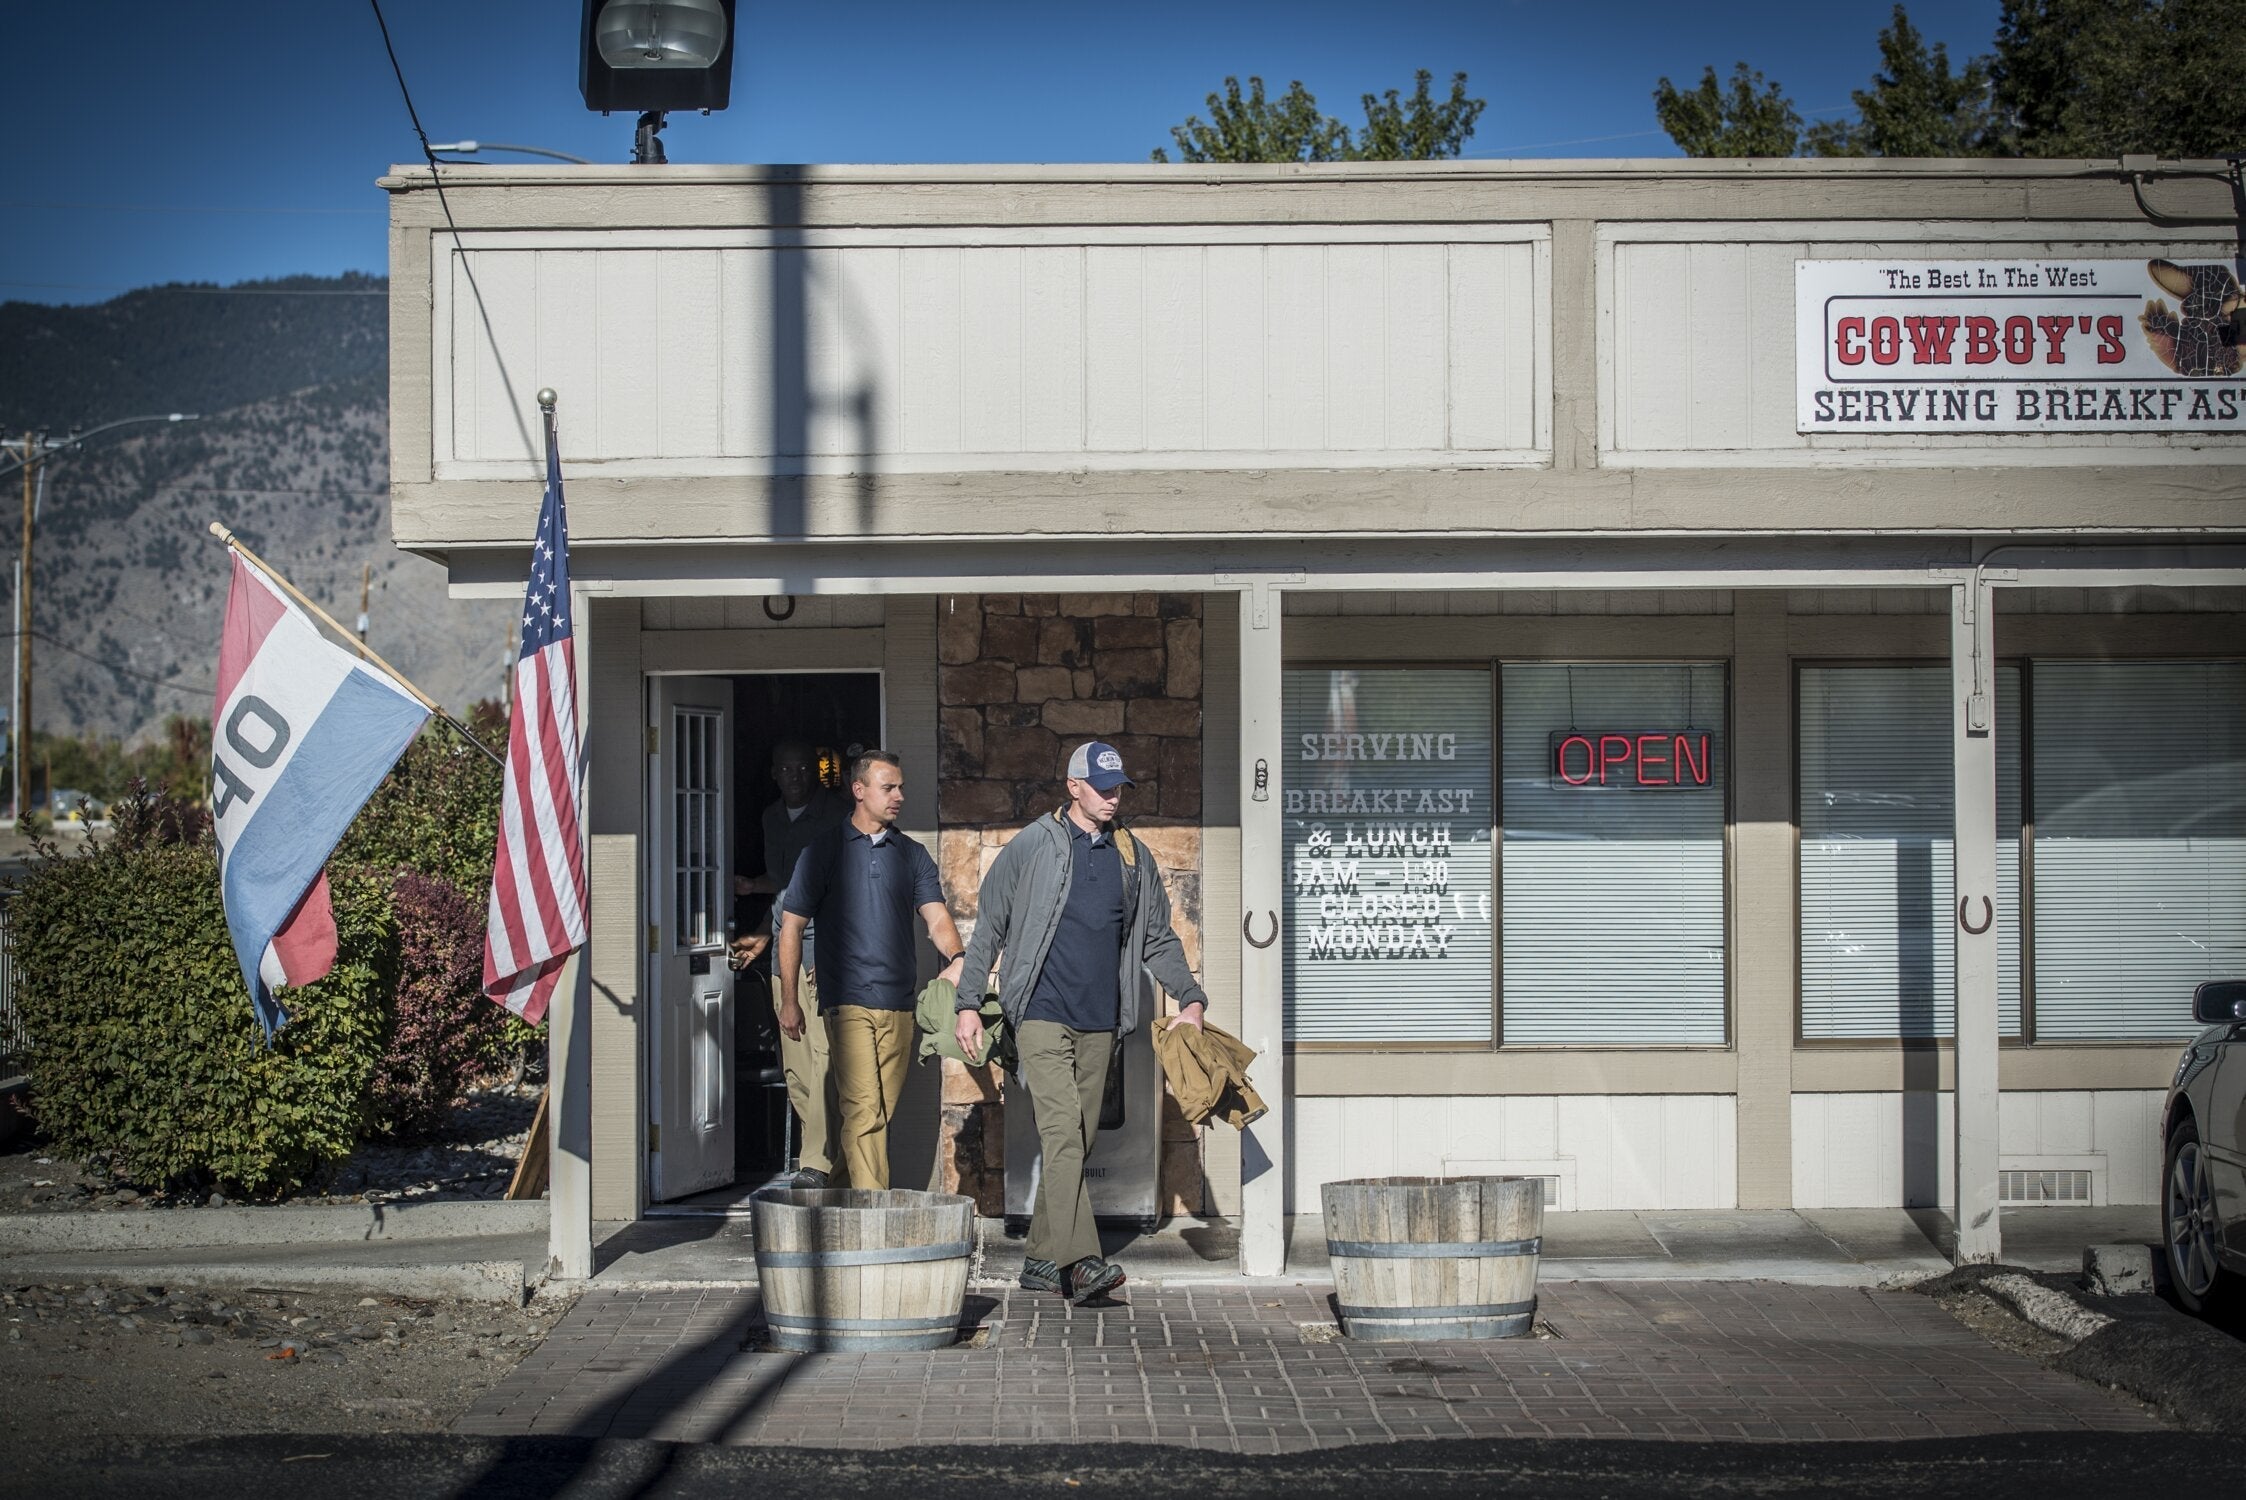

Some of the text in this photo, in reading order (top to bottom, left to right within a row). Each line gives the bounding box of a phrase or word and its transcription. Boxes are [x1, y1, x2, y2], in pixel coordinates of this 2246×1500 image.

[1927, 269, 1971, 289] Best
[1978, 269, 1998, 288] In
[2004, 268, 2038, 287] The
[2045, 267, 2098, 287] West
[1834, 316, 2126, 365] COWBOY'S
[1814, 389, 2246, 422] SERVING BREAKFAS
[1301, 733, 1456, 761] SERVING
[1558, 734, 1708, 785] OPEN
[1286, 788, 1473, 814] BREAKFAST
[1308, 822, 1452, 847] & LUNCH
[1286, 861, 1360, 885] 6AM
[1402, 861, 1448, 885] 1:30
[1321, 894, 1440, 918] CLOSED
[1308, 925, 1454, 950] MONDAY
